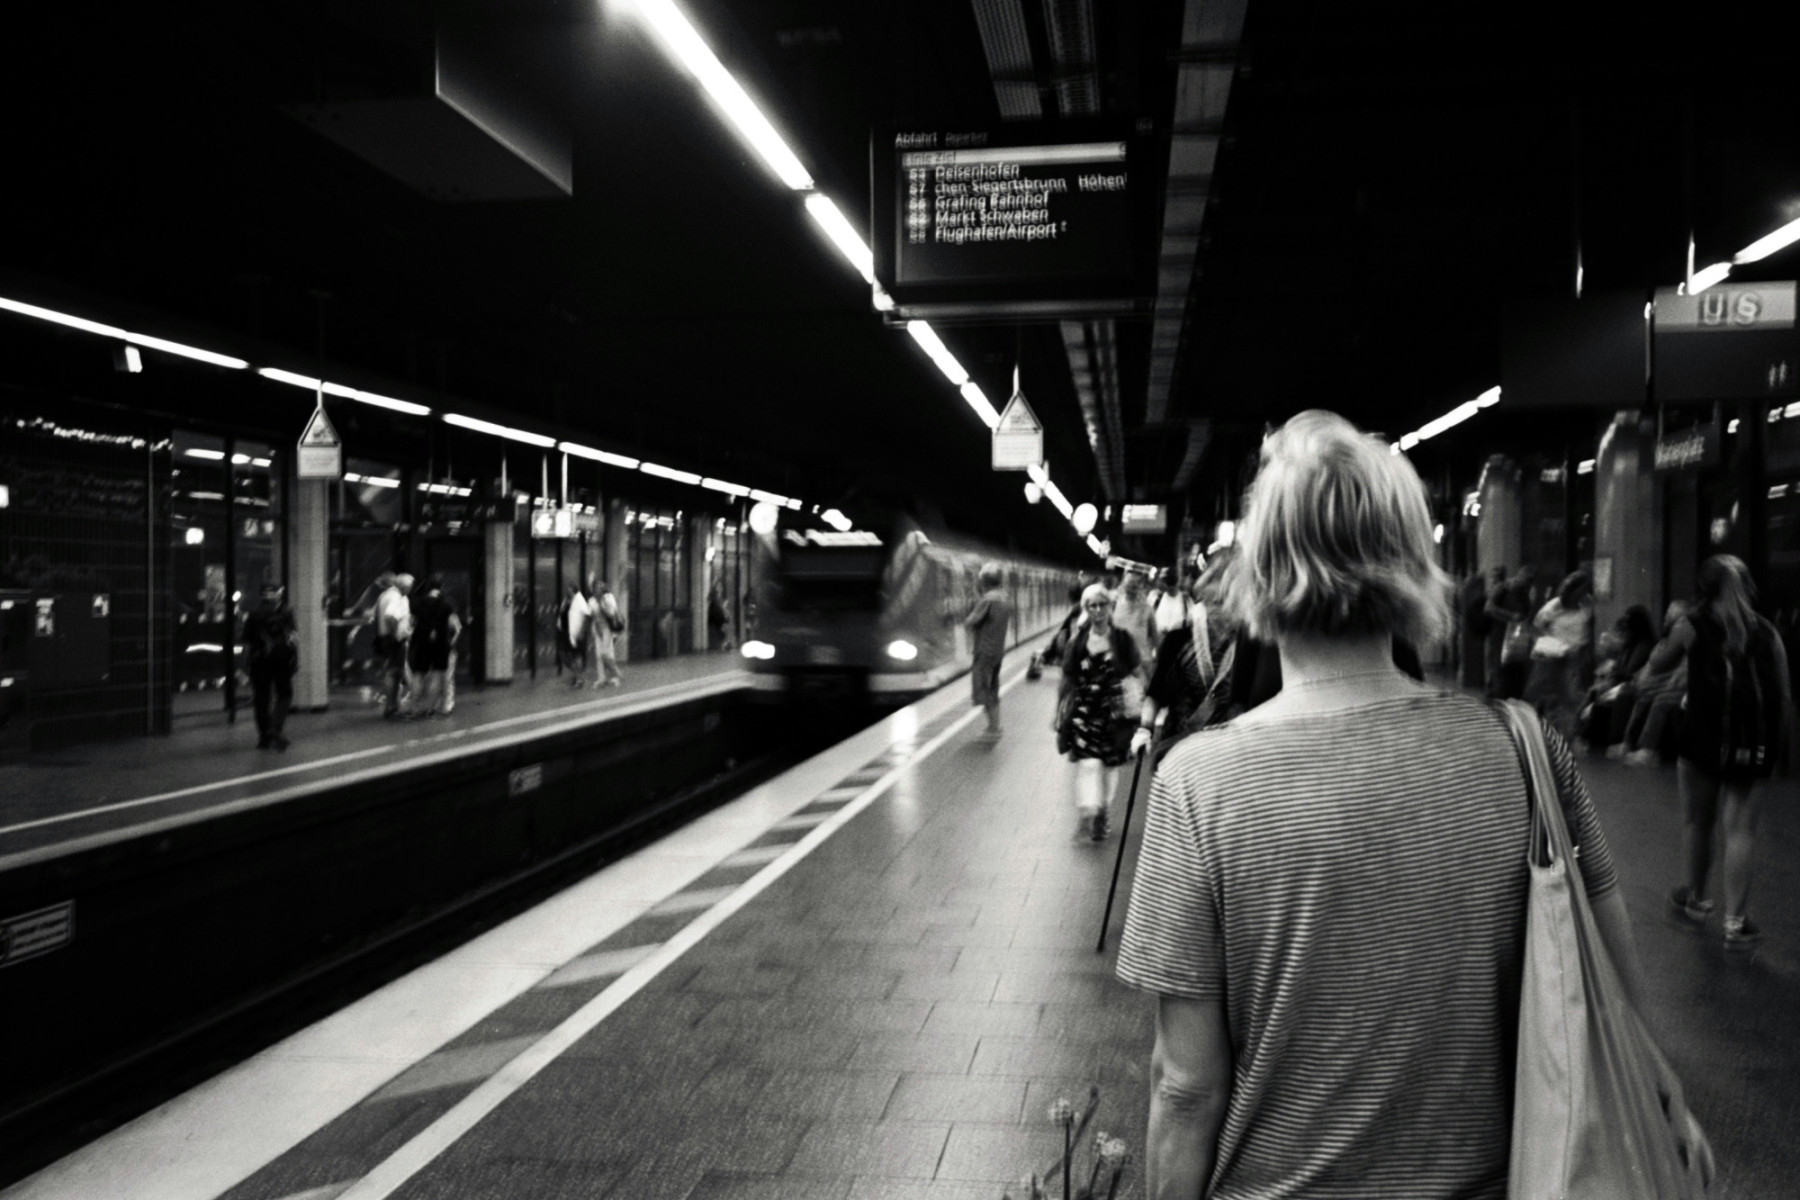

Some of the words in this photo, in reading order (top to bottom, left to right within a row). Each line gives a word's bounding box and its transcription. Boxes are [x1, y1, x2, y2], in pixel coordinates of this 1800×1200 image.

[895, 131, 938, 151] Abfahrt
[935, 163, 1020, 181] Deisenhofen
[935, 192, 986, 211] Grafing
[990, 189, 1049, 209] Bahnhof
[935, 210, 976, 227] Markt
[980, 207, 1048, 226] Schwaben
[935, 222, 1056, 243] Flughafen/Airport
